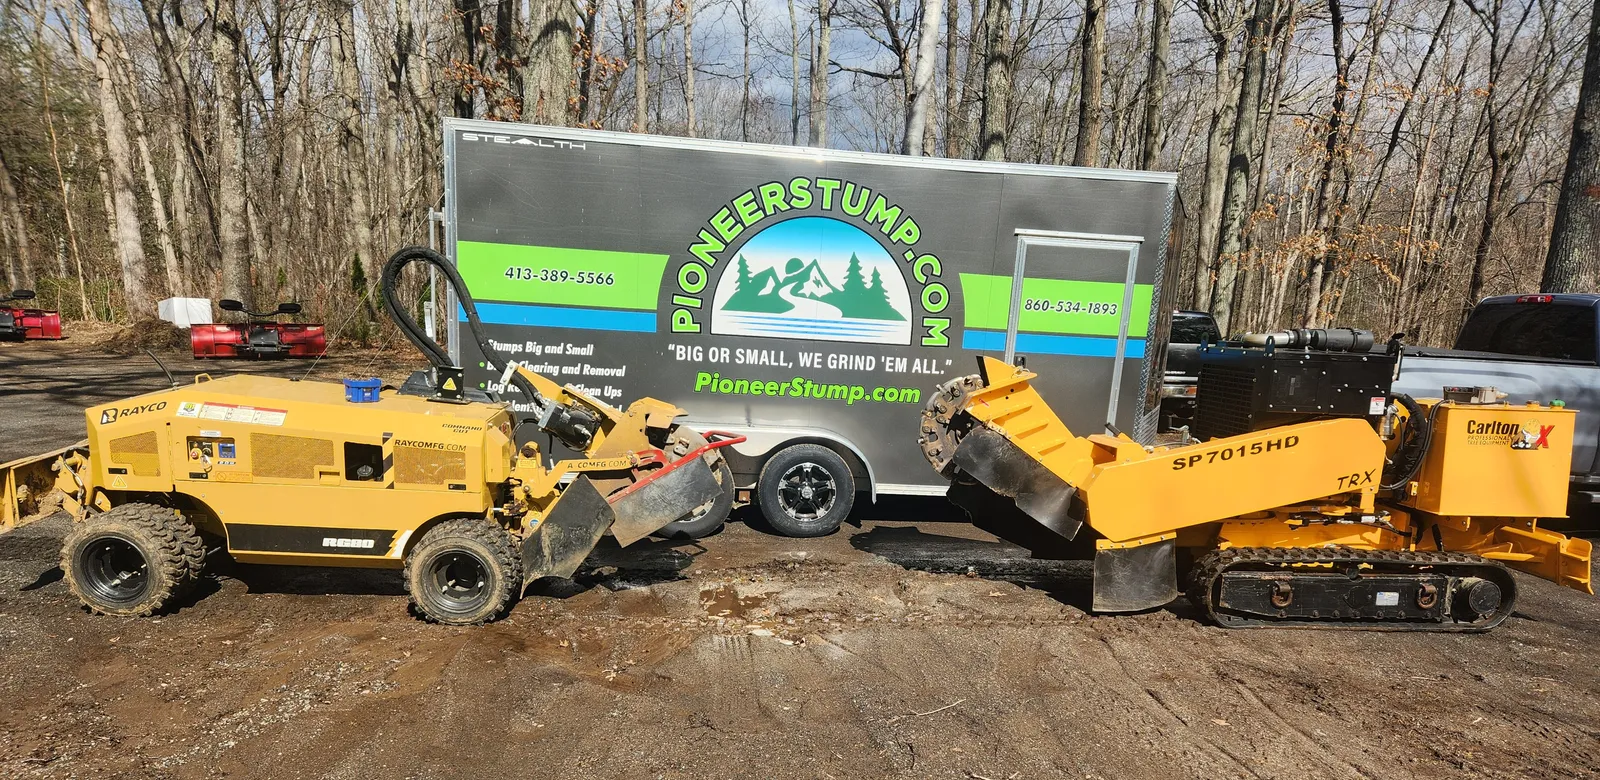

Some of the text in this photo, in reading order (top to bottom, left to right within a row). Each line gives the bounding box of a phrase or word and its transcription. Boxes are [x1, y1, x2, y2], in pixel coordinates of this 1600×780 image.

[462, 132, 586, 151] STEALTH
[671, 177, 950, 347] PIONEERSTUMP.COM
[504, 266, 615, 286] 413-389-5566
[1024, 298, 1118, 316] 860-534-1893
[488, 339, 594, 356] Stumps Big and Small
[708, 346, 731, 364] OR
[734, 347, 794, 369] SMALL,
[798, 352, 823, 369] WE
[827, 353, 876, 372] GRIND
[881, 355, 907, 374] 'EM
[561, 363, 582, 375] and
[582, 364, 627, 378] Removal
[487, 380, 505, 395] Log
[604, 385, 622, 399] Ups
[694, 371, 921, 405] PioneerStump.com
[119, 401, 167, 418] RAYCO
[1467, 419, 1520, 435] Carlton
[394, 439, 467, 452] RAYCOMFG.COM
[1172, 435, 1300, 471] SP7015HD
[1336, 469, 1376, 490] TRX
[322, 537, 375, 549] RG80
